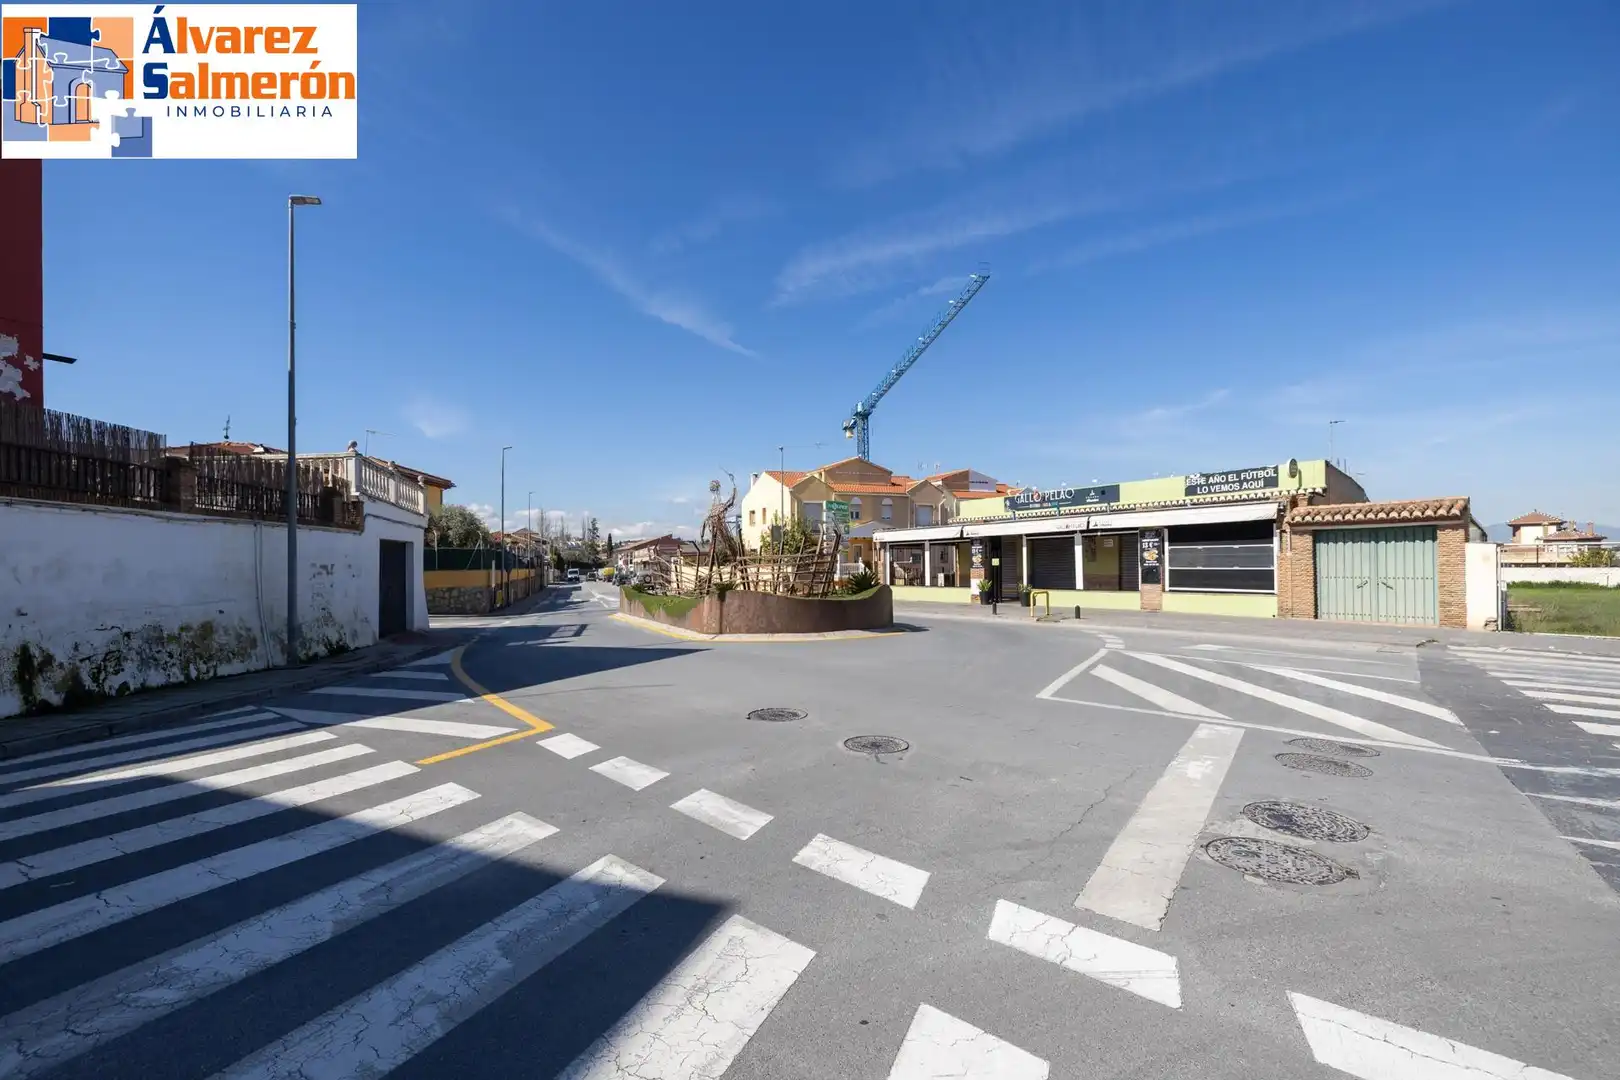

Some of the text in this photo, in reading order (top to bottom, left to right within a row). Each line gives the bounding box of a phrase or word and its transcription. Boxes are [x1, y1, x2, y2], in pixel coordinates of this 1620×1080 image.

[1186, 475, 1207, 486] ESTE
[1208, 473, 1226, 484] AÑO
[1229, 474, 1240, 482] EL
[1241, 468, 1277, 480] FÚTBOL
[1197, 479, 1264, 494] LO VEMOS AQUÍ
